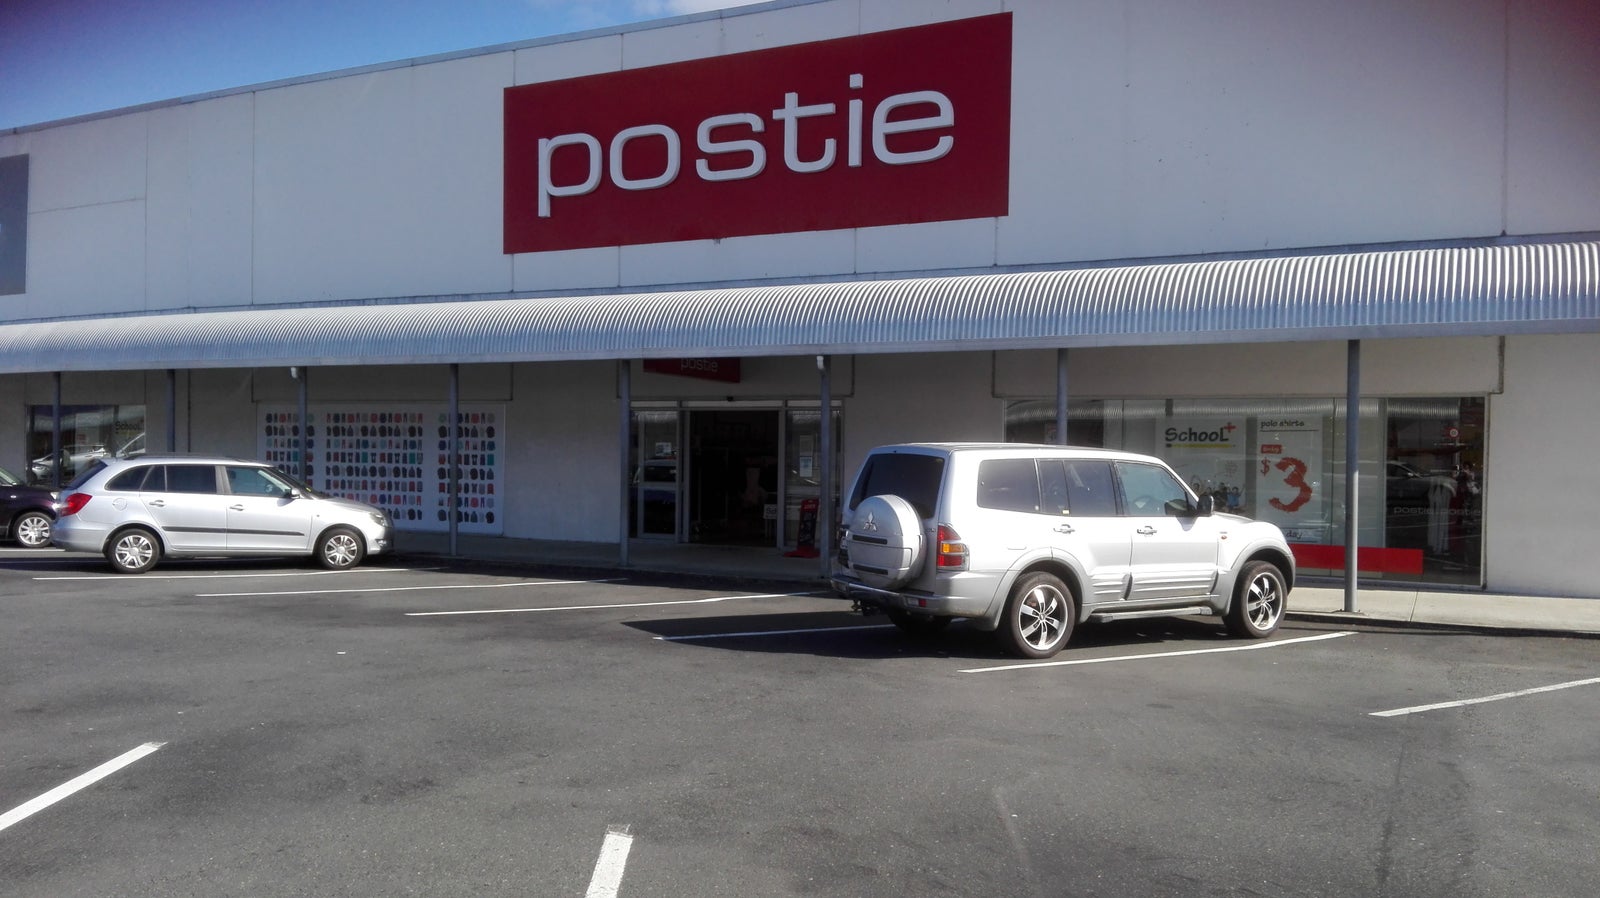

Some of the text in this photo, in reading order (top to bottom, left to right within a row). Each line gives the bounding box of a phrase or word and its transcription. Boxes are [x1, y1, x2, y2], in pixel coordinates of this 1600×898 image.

[537, 73, 955, 218] postie
[681, 356, 718, 373] postie
[1260, 418, 1305, 429] polo shirts
